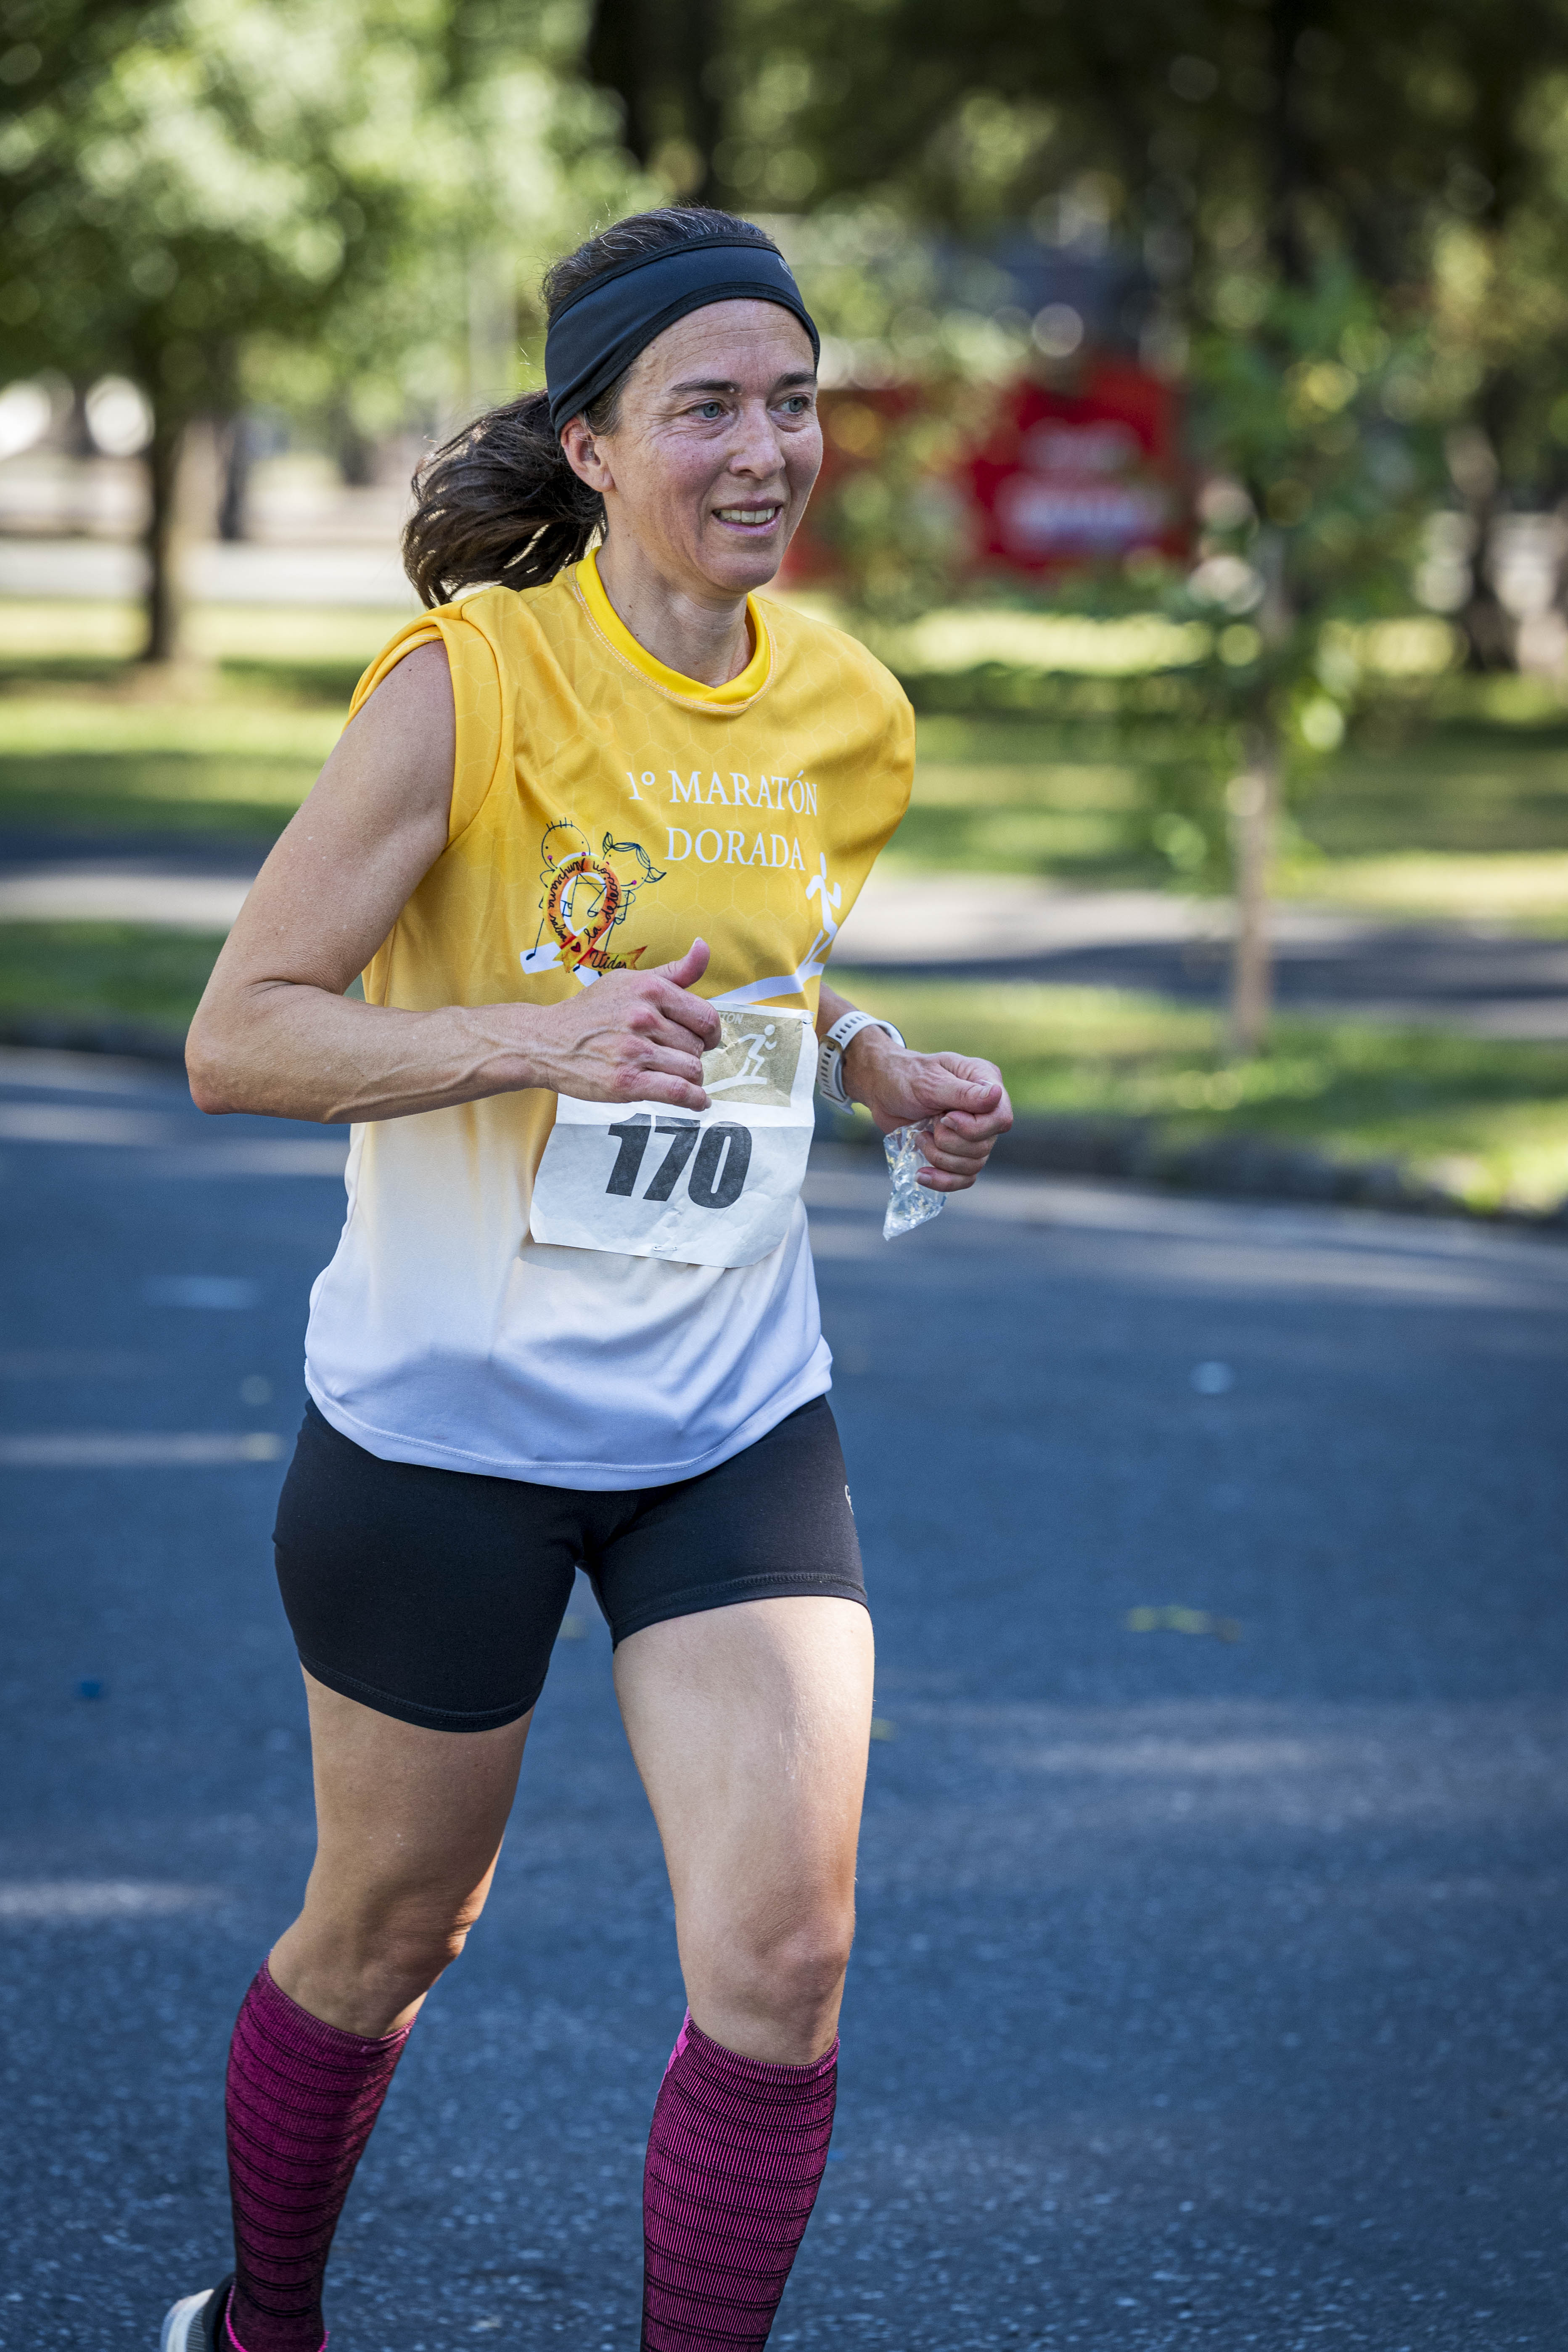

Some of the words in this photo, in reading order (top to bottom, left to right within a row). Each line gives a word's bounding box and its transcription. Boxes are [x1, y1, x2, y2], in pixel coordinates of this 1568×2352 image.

[668, 770, 817, 816] MARATÓN
[664, 827, 806, 870] DORADA
[606, 1113, 752, 1209] 170
